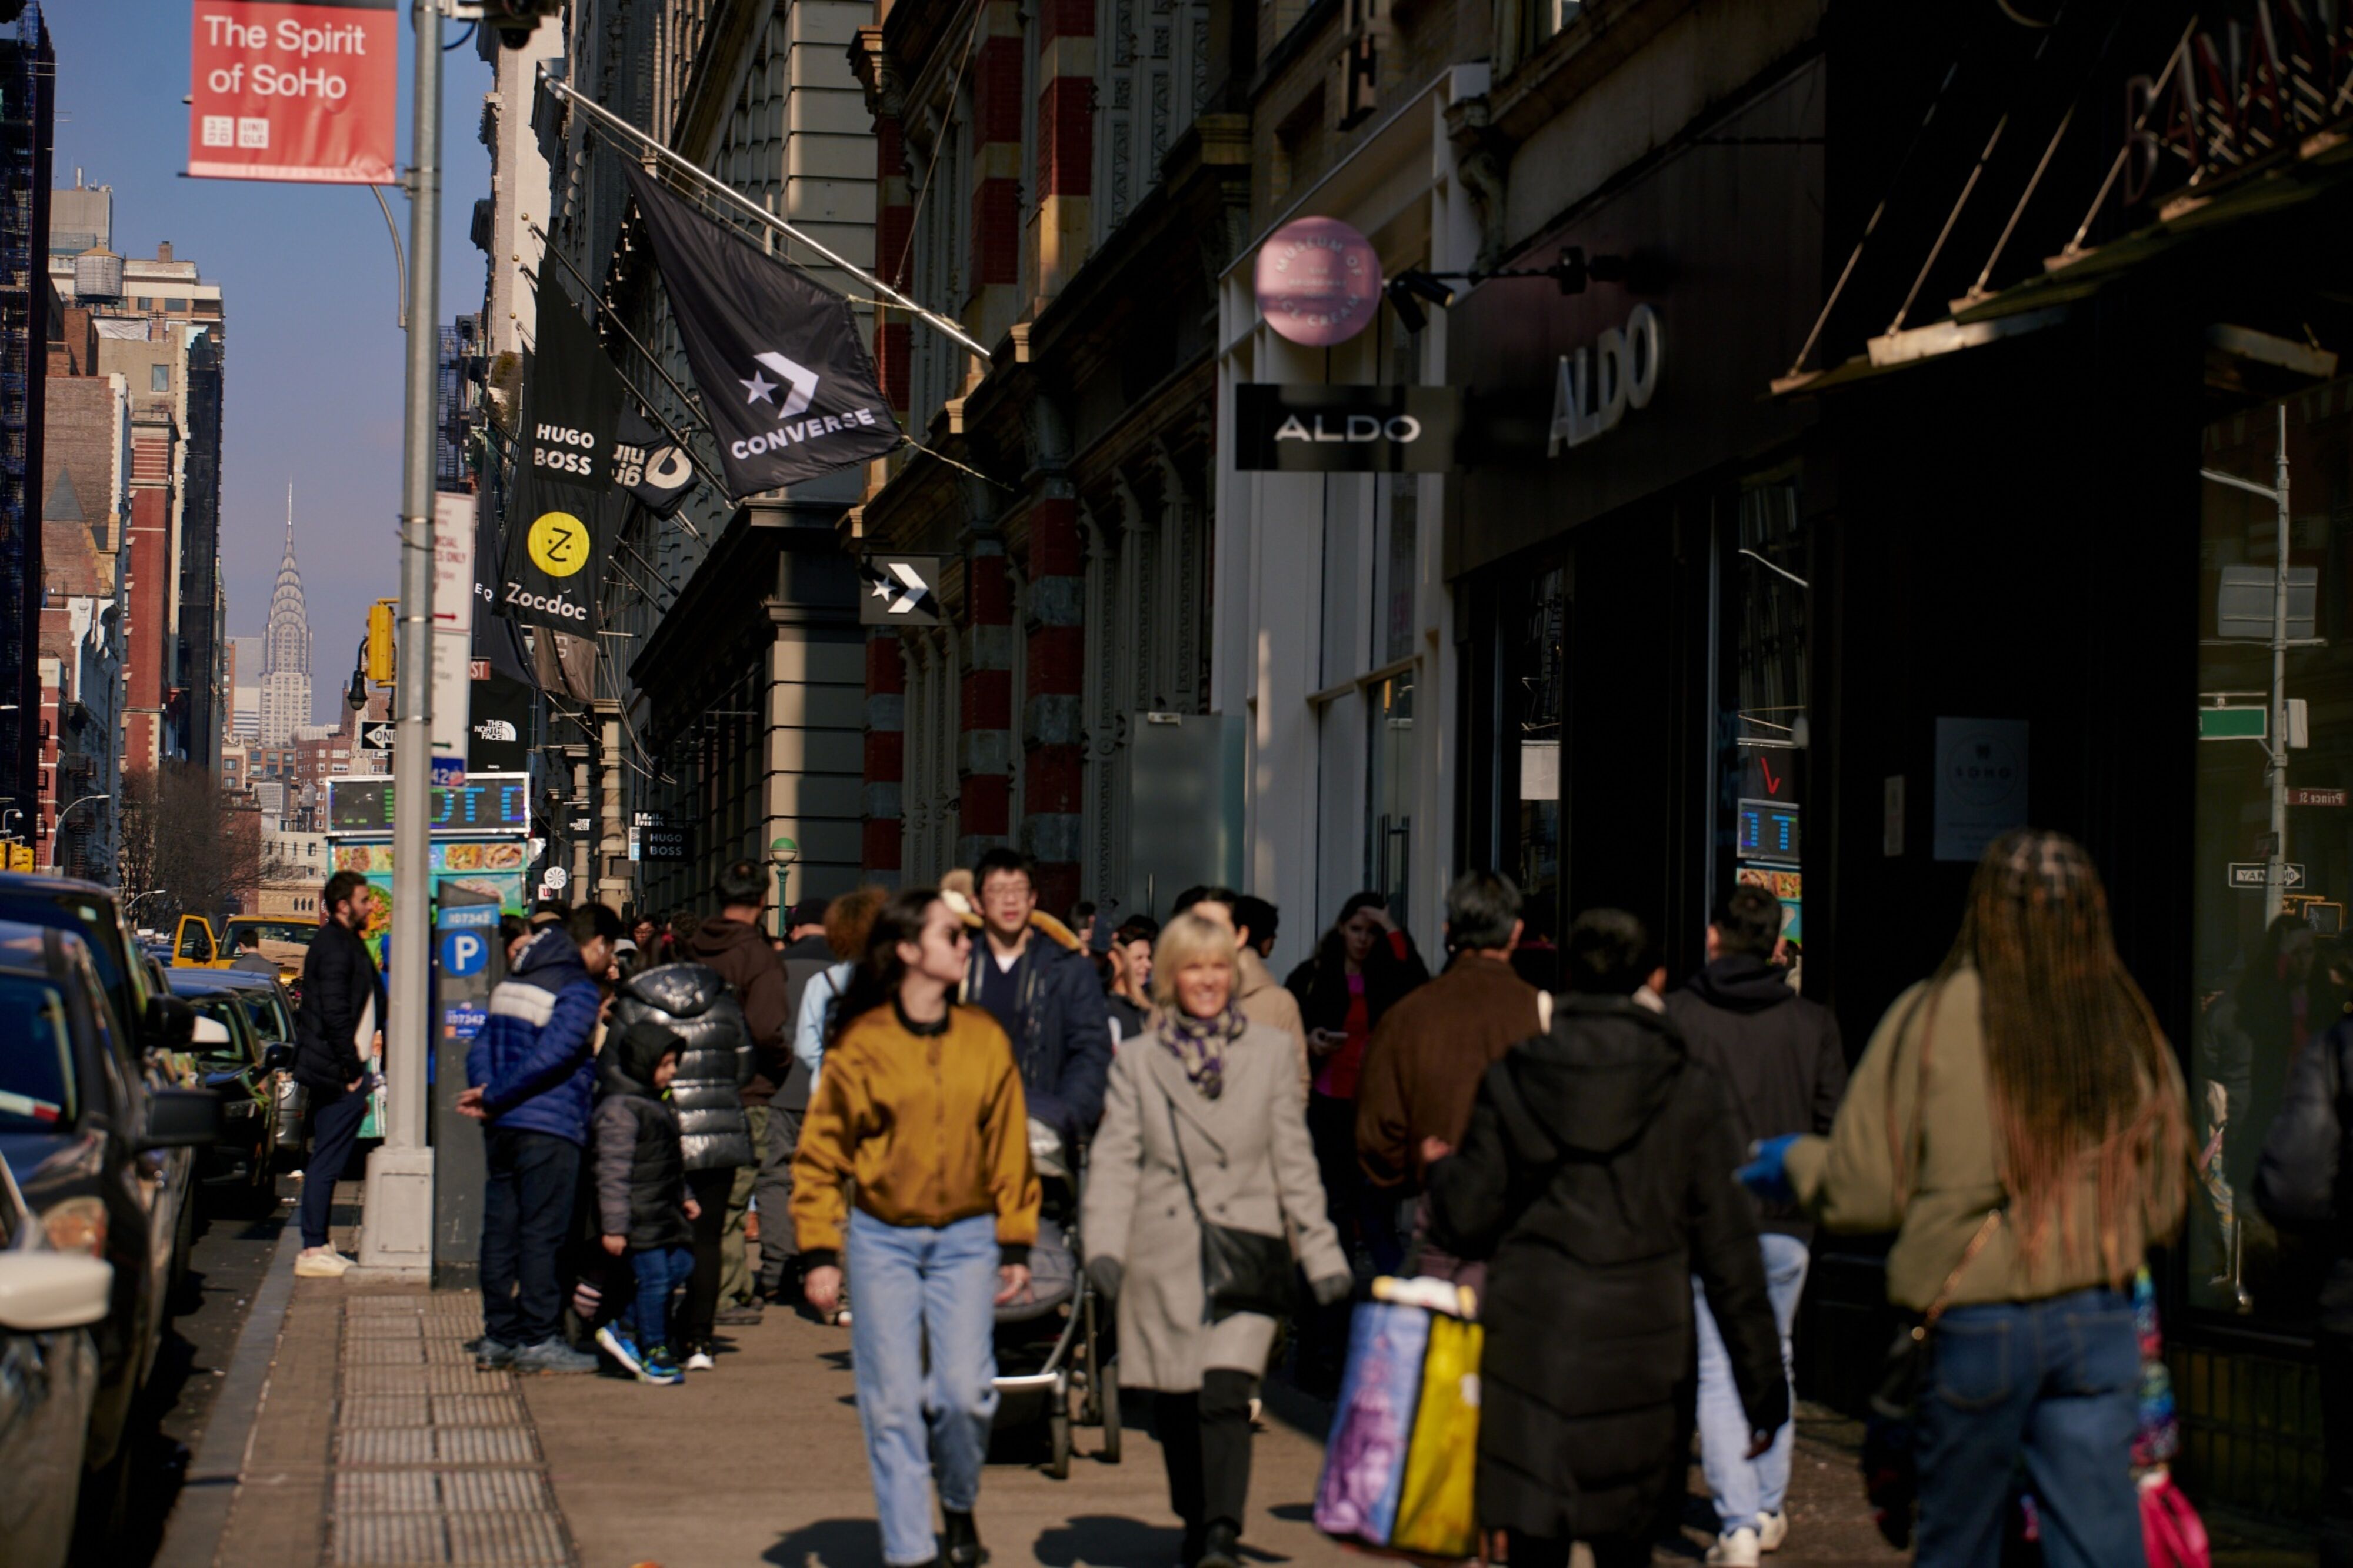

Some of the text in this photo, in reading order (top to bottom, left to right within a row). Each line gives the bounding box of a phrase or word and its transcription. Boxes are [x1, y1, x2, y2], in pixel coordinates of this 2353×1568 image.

[203, 15, 366, 58] The Spirit
[208, 63, 346, 99] of SoHo
[1276, 236, 1362, 275] MUSEUM OF
[1547, 302, 1664, 459] ALDO
[536, 423, 595, 449] HUGO
[731, 408, 875, 459] CONVERSE
[1273, 413, 1422, 443] ALDO
[534, 447, 592, 476] BOSS
[506, 581, 587, 620] Zocdoc
[474, 725, 502, 735] NORTH
[481, 732, 502, 740] FACE
[486, 719, 502, 728] THE
[635, 813, 664, 827] Milk
[649, 833, 682, 843] HUGO
[649, 845, 682, 856] BOSS
[455, 936, 479, 970] P
